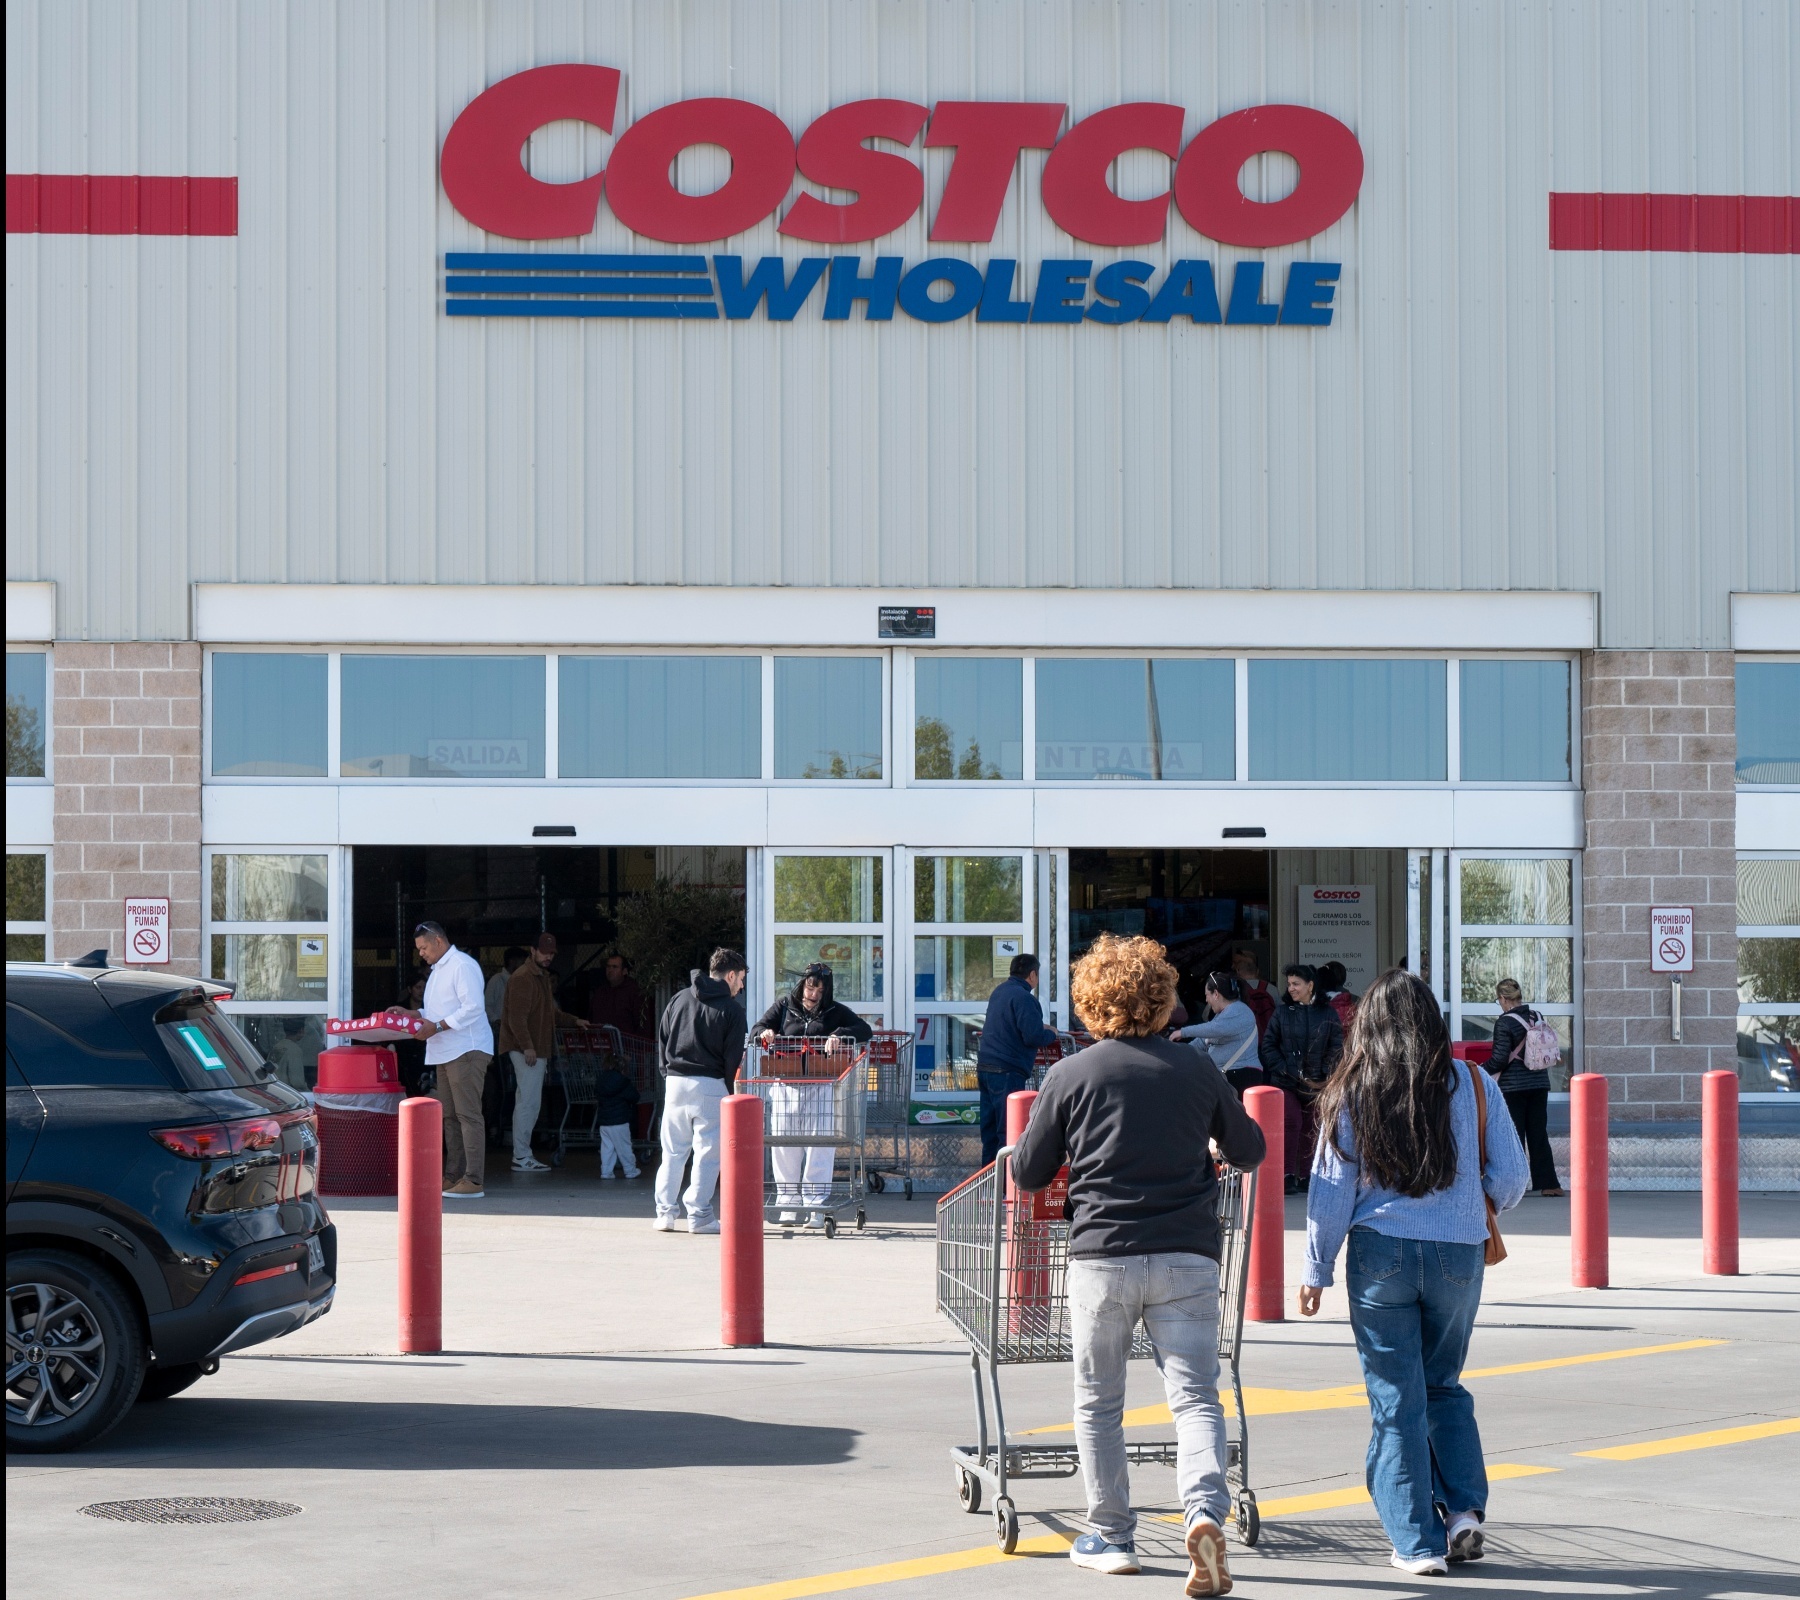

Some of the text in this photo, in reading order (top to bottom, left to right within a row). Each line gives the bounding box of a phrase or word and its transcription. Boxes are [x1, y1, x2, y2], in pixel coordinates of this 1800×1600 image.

[440, 63, 1365, 249] COSTCO
[712, 254, 1342, 326] WHOLESALE
[435, 746, 521, 765] SALIDA
[1313, 890, 1360, 899] COSTCO
[128, 906, 166, 914] PROHIBIDO
[134, 916, 159, 926] FUMAR
[1654, 915, 1690, 924] PROHIBIDO
[1660, 926, 1684, 935] FUMAR
[916, 1018, 930, 1040] 7
